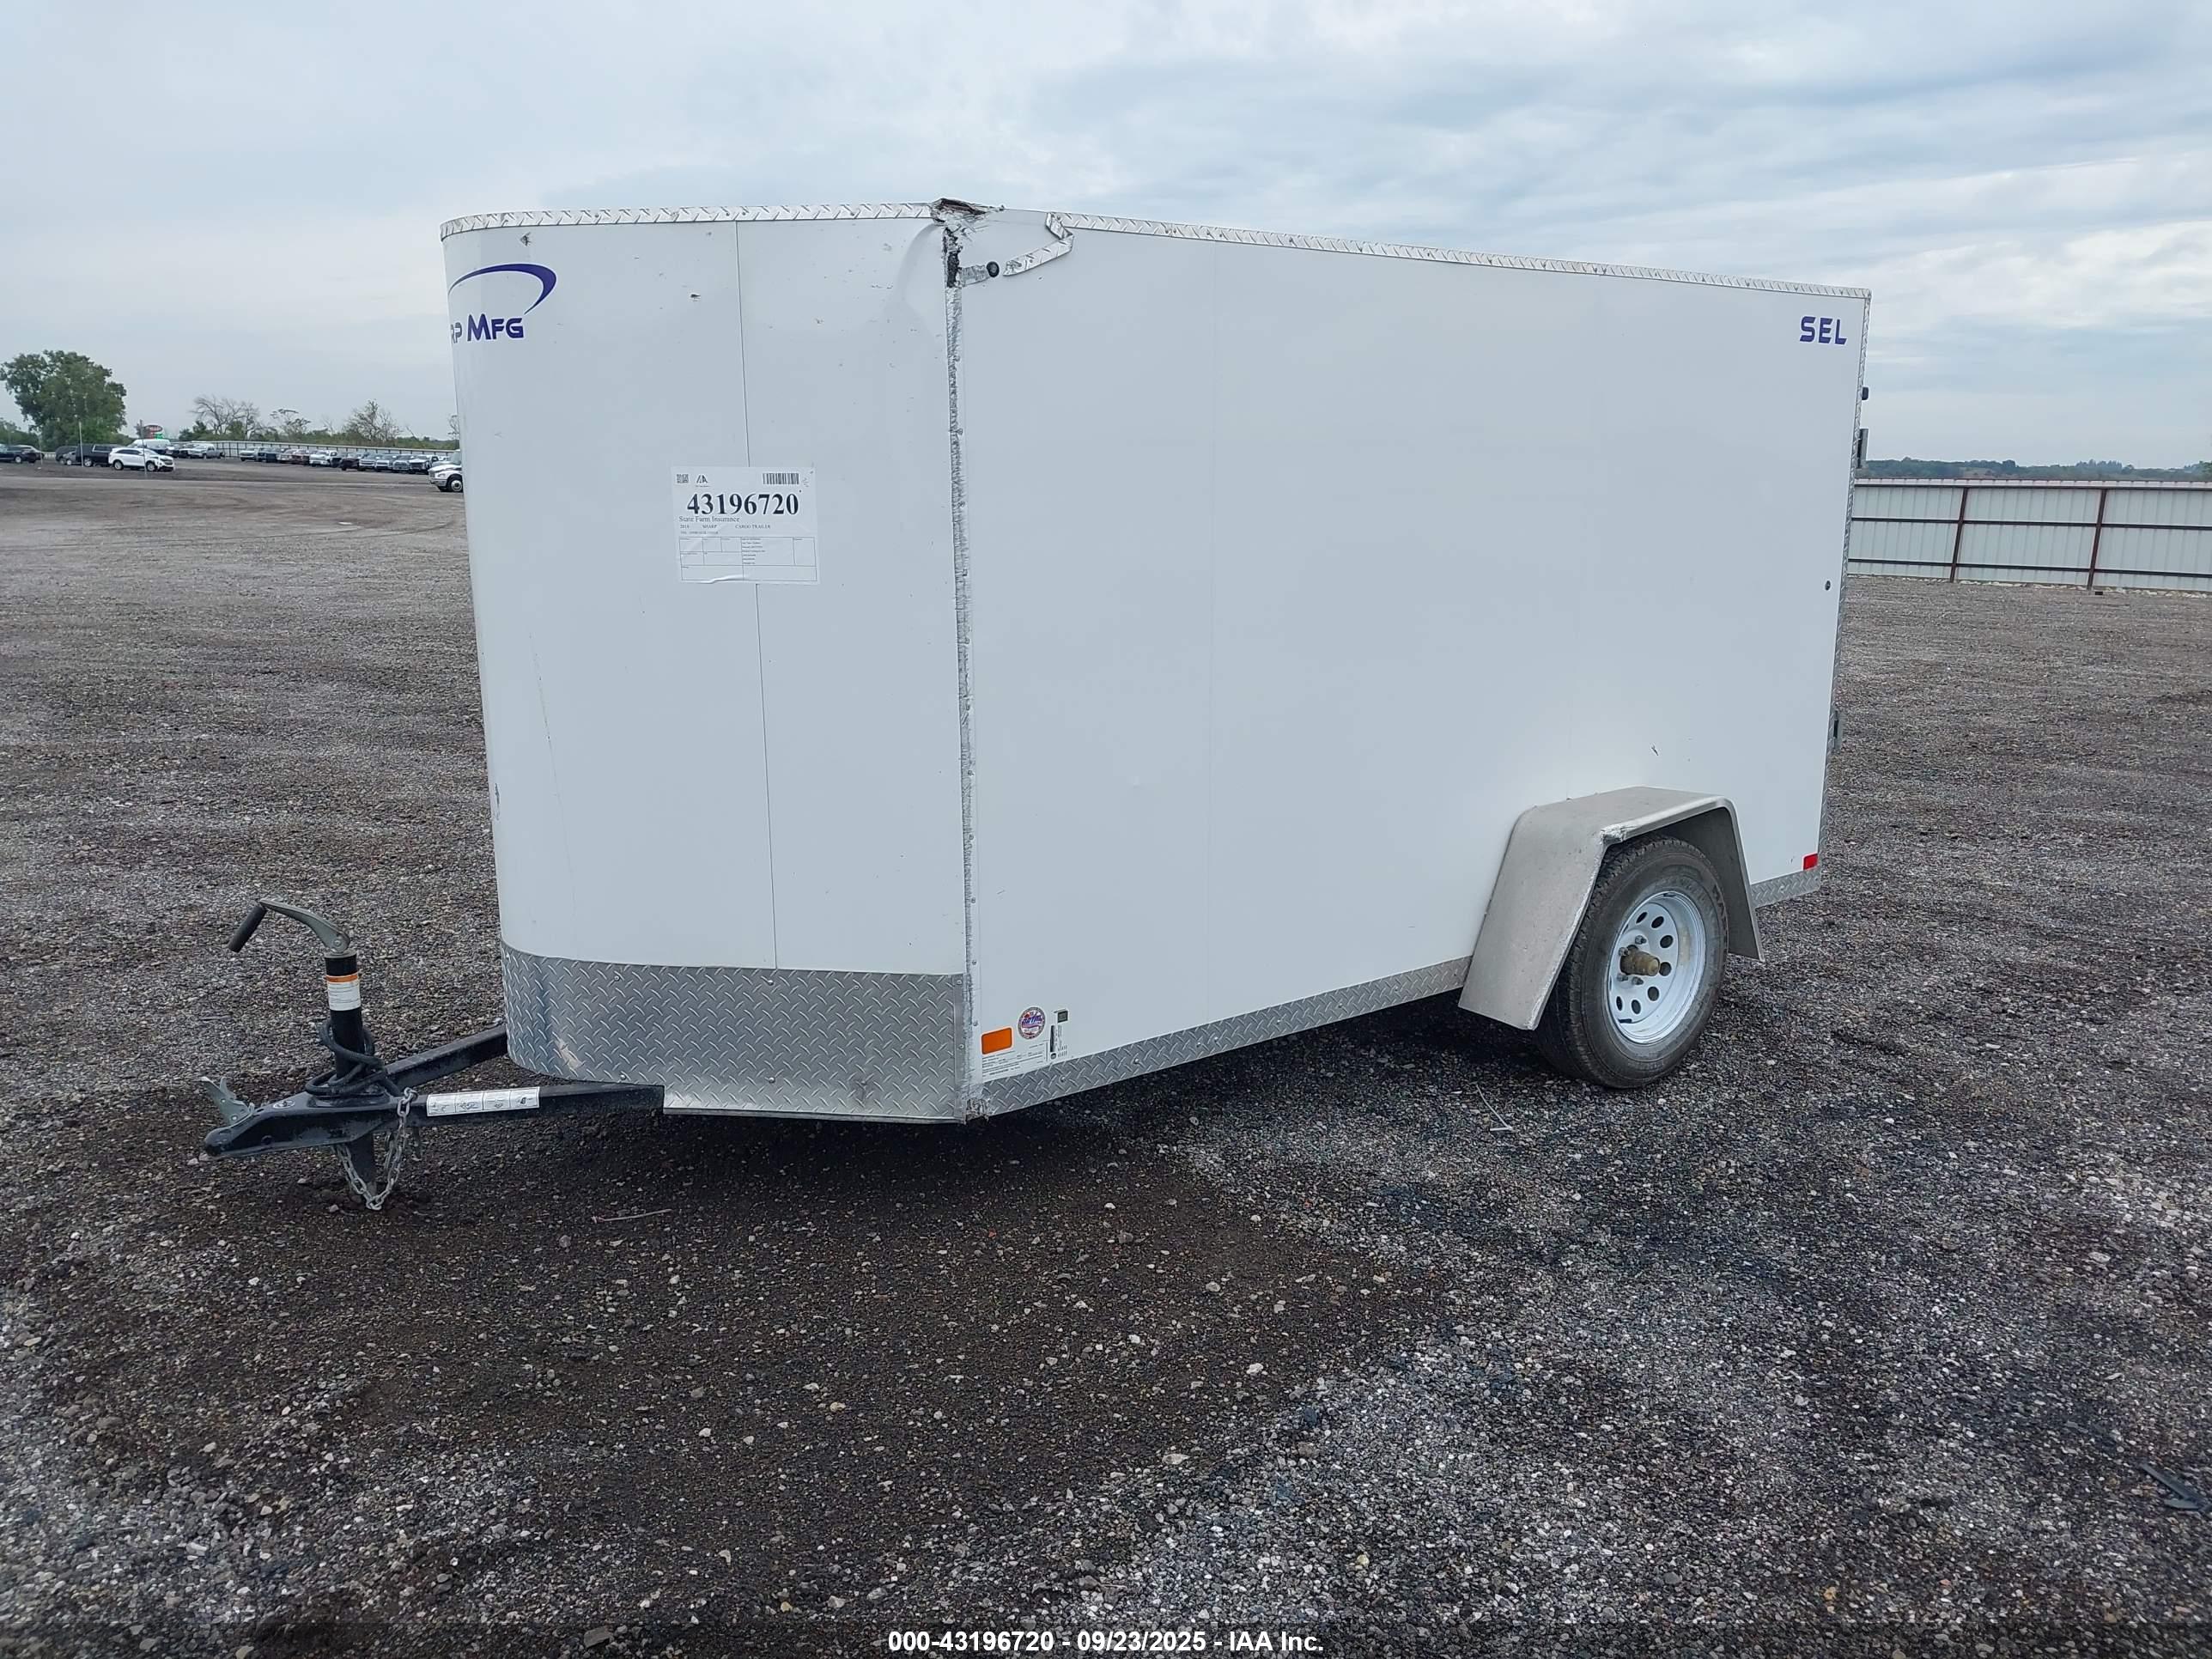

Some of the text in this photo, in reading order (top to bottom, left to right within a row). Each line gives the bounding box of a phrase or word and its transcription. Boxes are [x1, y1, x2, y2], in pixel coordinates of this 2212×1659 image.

[467, 313, 524, 341] MFG
[1800, 315, 1847, 345] SEL
[687, 493, 799, 514] 43196720
